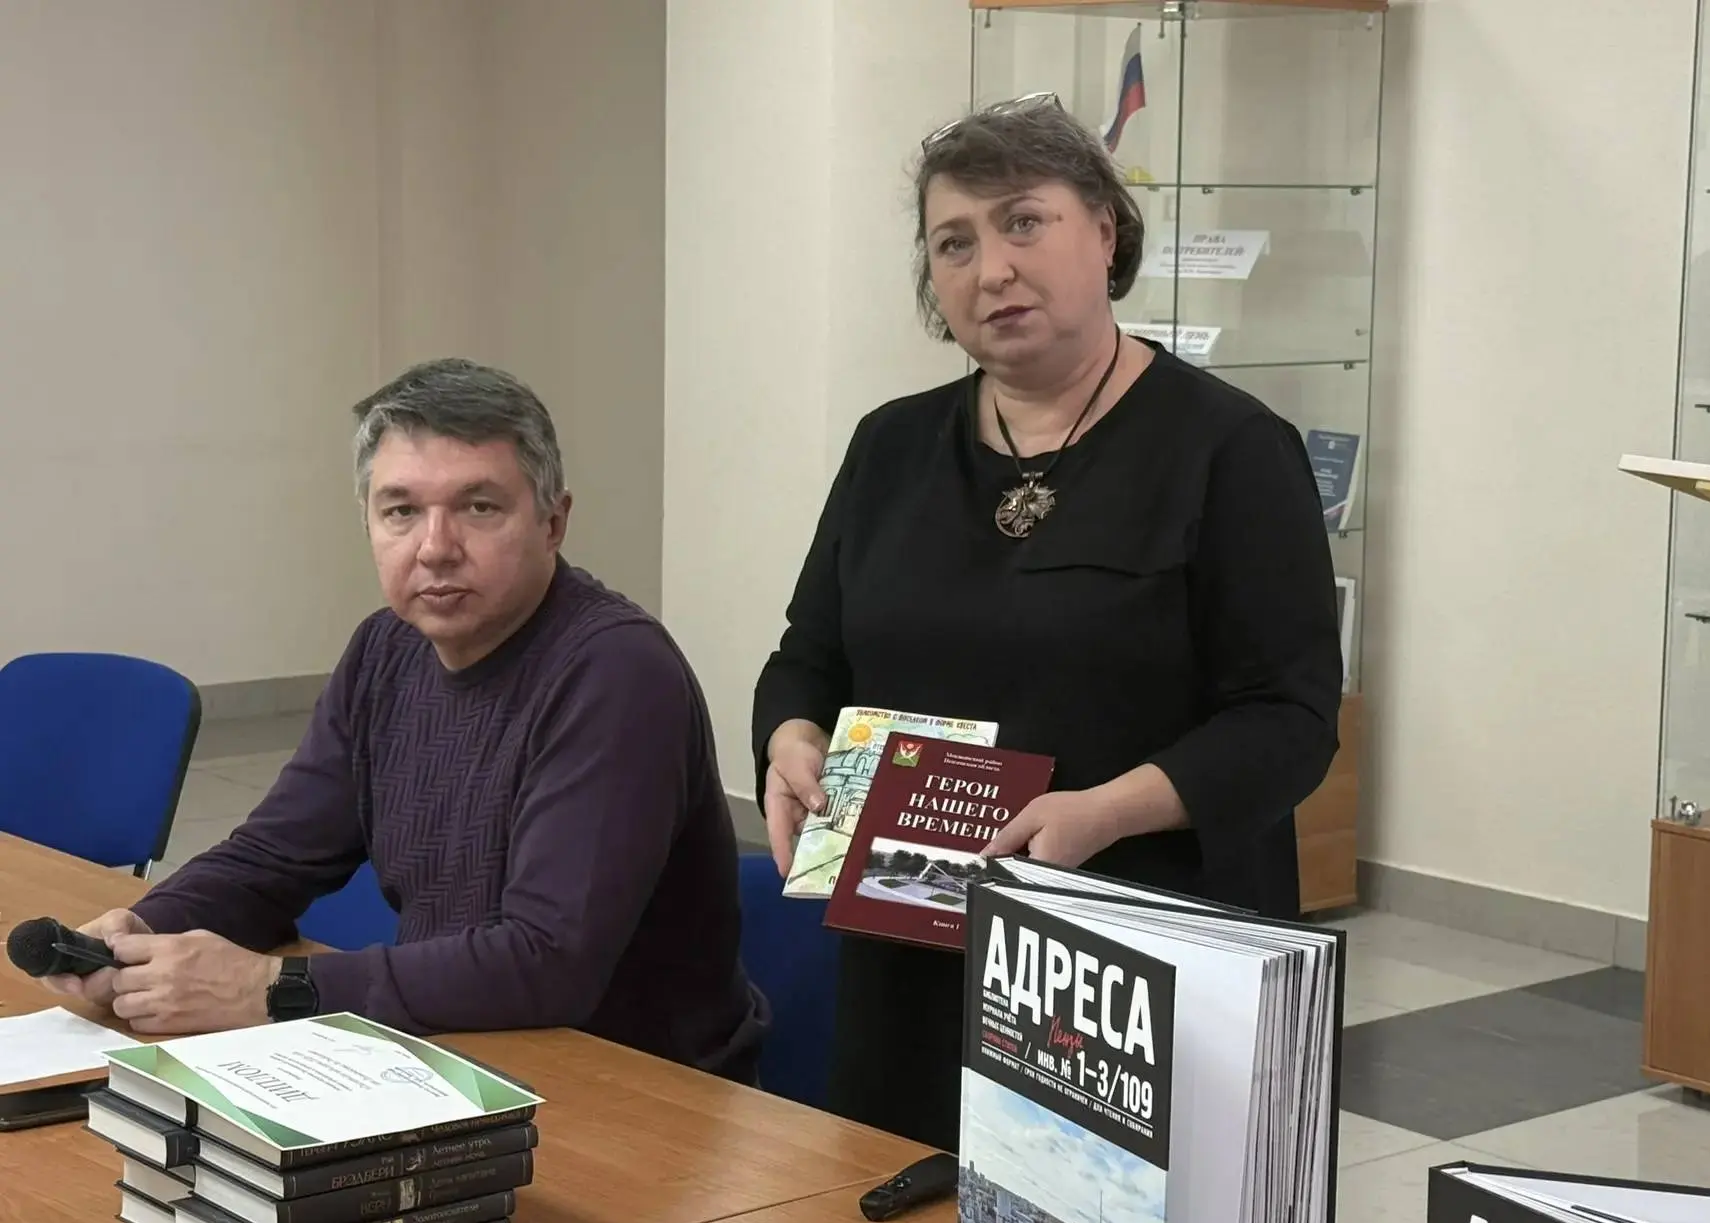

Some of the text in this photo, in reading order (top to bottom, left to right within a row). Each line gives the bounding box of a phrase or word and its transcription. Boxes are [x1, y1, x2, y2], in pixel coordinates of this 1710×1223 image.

[1193, 234, 1226, 244] ПРАВА
[956, 721, 977, 731] КВЕСТА
[925, 774, 1000, 799] ГЕРОИ
[908, 793, 1010, 821] НАШЕГО
[983, 915, 1155, 1065] АДРЕСА
[1037, 1048, 1057, 1073] ИНВ.
[1060, 1056, 1072, 1080] №
[217, 1060, 320, 1103] ДИПЛОМ
[1002, 1056, 1020, 1071] ФОРМАТ
[1103, 1107, 1121, 1123] ЧТЕНИЯ
[1126, 1119, 1153, 1139] СОБИРАНИЯ
[331, 1165, 395, 1189] БРЭДБЕРИ
